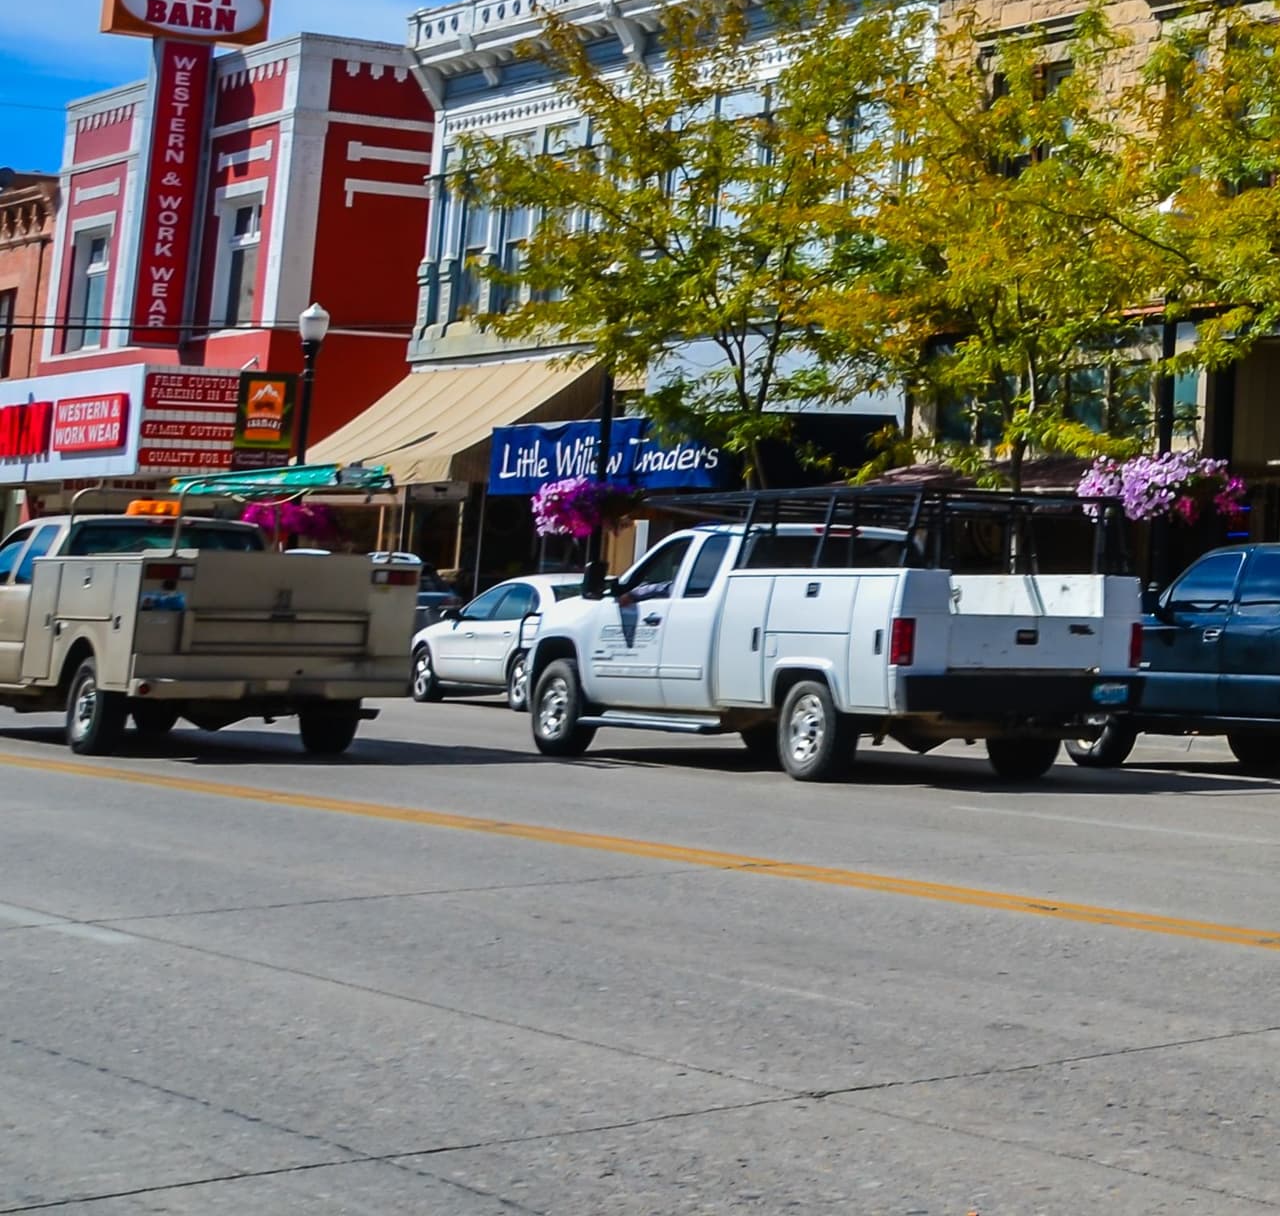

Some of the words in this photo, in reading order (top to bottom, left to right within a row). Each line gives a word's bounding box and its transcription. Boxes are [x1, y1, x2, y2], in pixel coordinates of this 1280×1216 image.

[165, 55, 197, 164] WESTERN
[161, 171, 182, 186] &
[154, 195, 182, 257] WORK
[148, 266, 175, 327] WEAR
[154, 375, 184, 387] FREE
[151, 388, 203, 400] PARKING
[207, 390, 220, 401] IN
[59, 401, 109, 422] WESTERN
[111, 399, 120, 417] &
[55, 427, 86, 445] WORK
[88, 422, 120, 443] WEAR
[145, 424, 186, 436] FAMILY
[148, 452, 195, 463] QUALITY
[199, 453, 219, 464] FOR
[499, 439, 550, 478] Little
[629, 437, 719, 472] Traders
